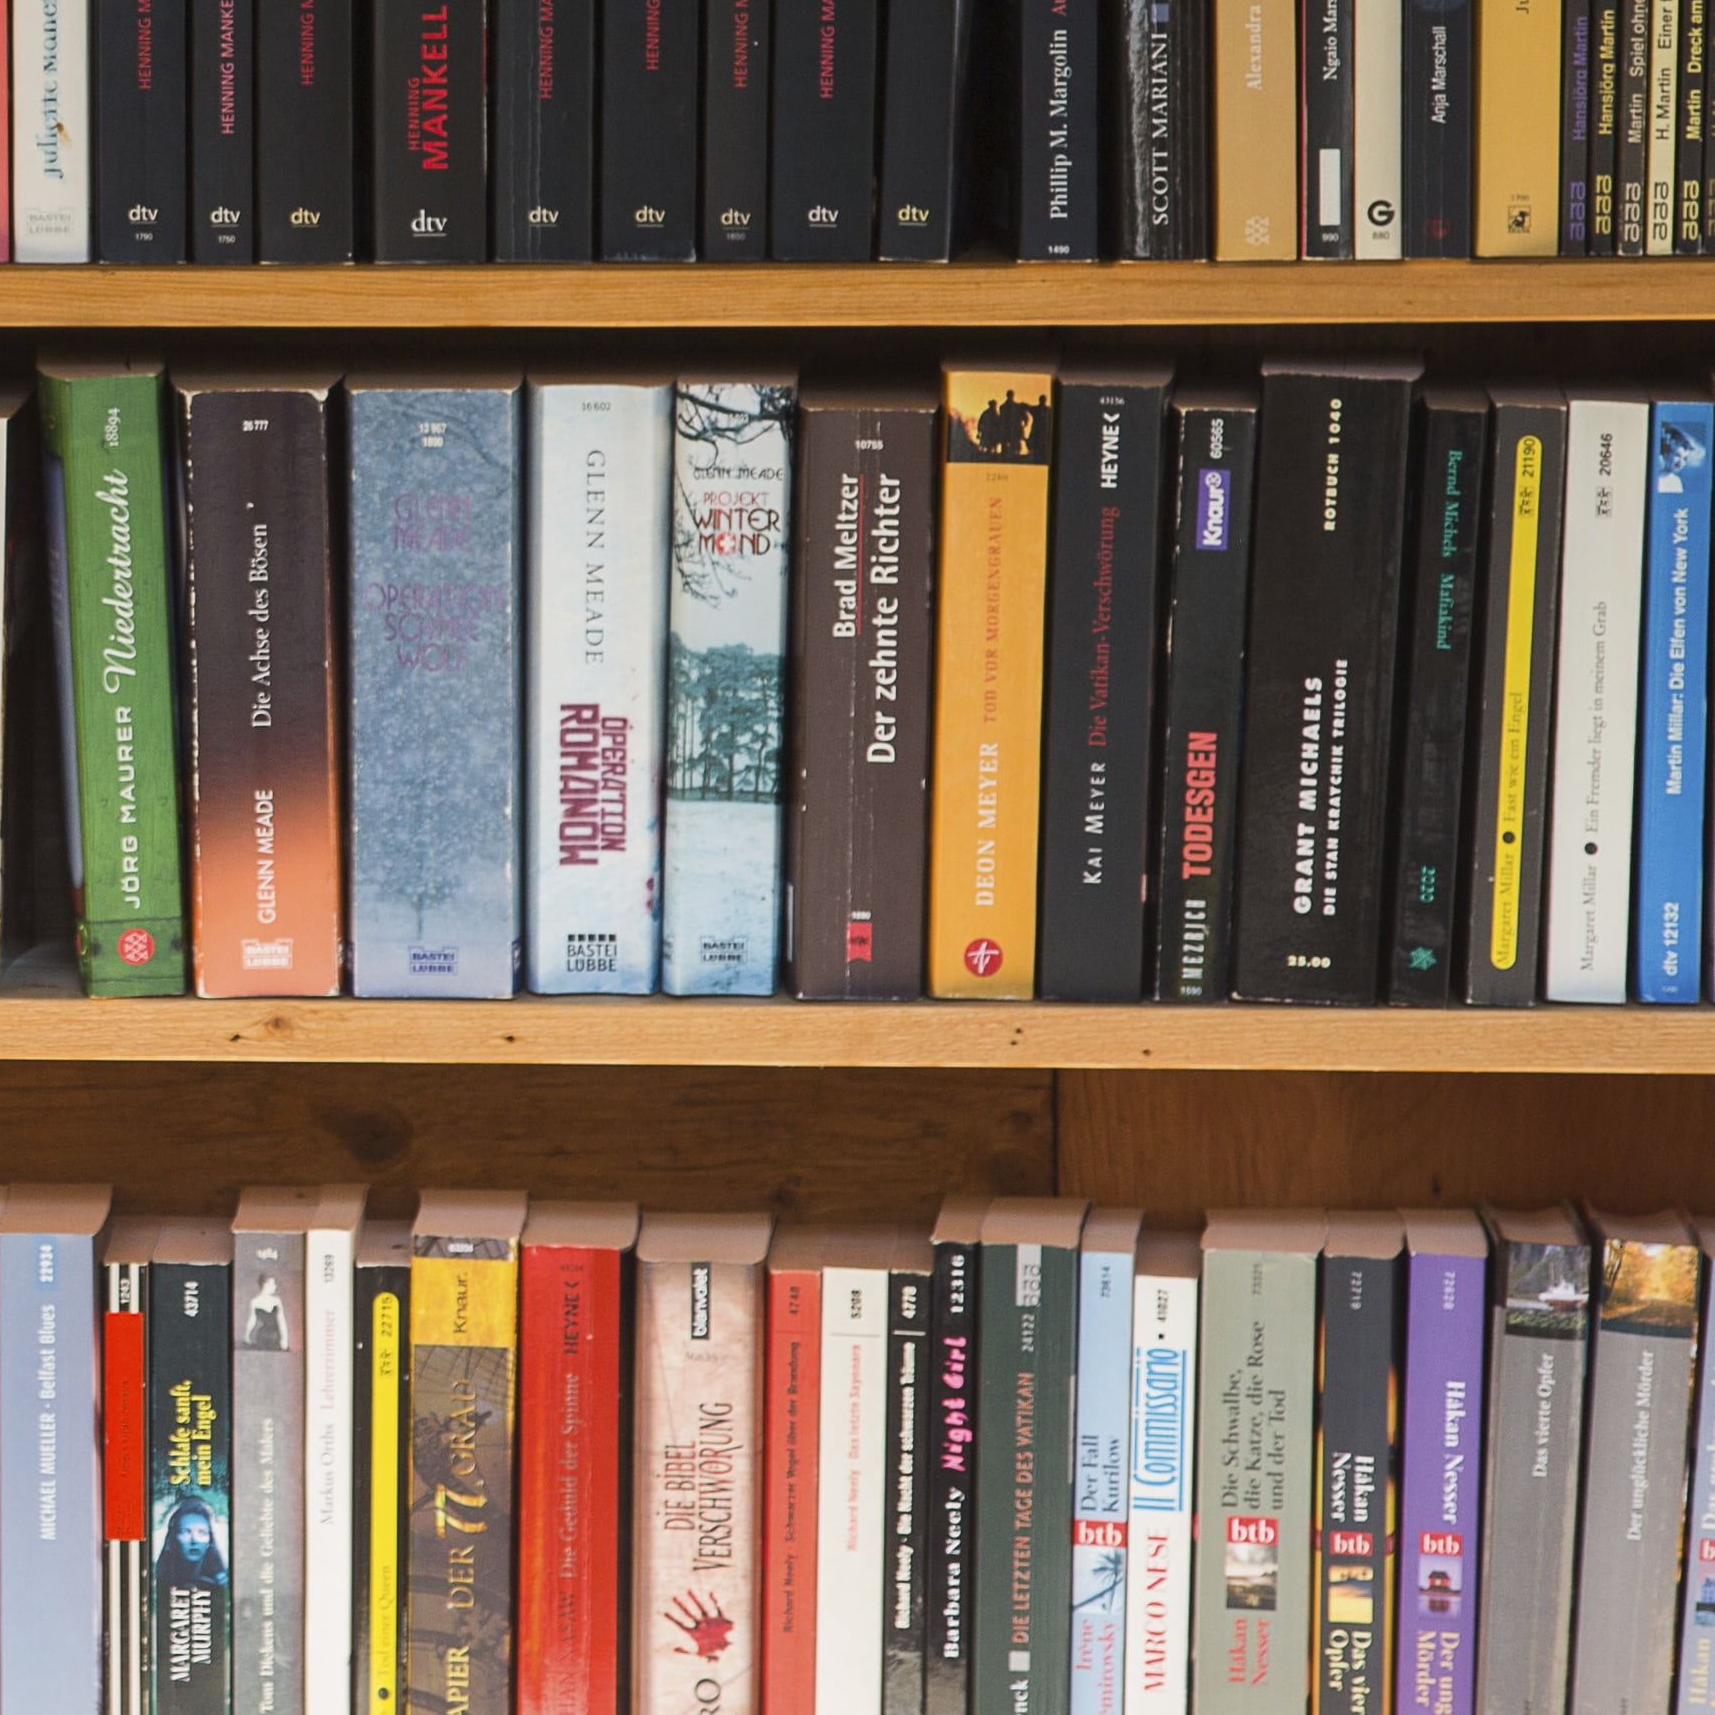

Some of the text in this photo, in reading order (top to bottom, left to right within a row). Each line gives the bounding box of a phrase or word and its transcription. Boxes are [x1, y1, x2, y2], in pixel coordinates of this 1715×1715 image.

[406, 76, 421, 151] HENNING
[421, 5, 448, 172] MANKELL
[1152, 33, 1168, 225] SCOTT MARIANI
[412, 211, 448, 234] dtv
[1100, 426, 1117, 488] HEYNE
[867, 474, 902, 765] Der zehnte Richter
[560, 703, 598, 866] ROMANOW
[1184, 730, 1217, 879] TODESGEN
[1293, 677, 1322, 915] GRANT MICHAELS
[566, 941, 618, 956] BASTEI
[1288, 957, 1330, 969] 25.00
[693, 1268, 708, 1337] blanvalet
[1229, 1519, 1276, 1543] btb
[170, 1587, 189, 1683] MARGARET
[191, 1586, 212, 1665] MURPHY
